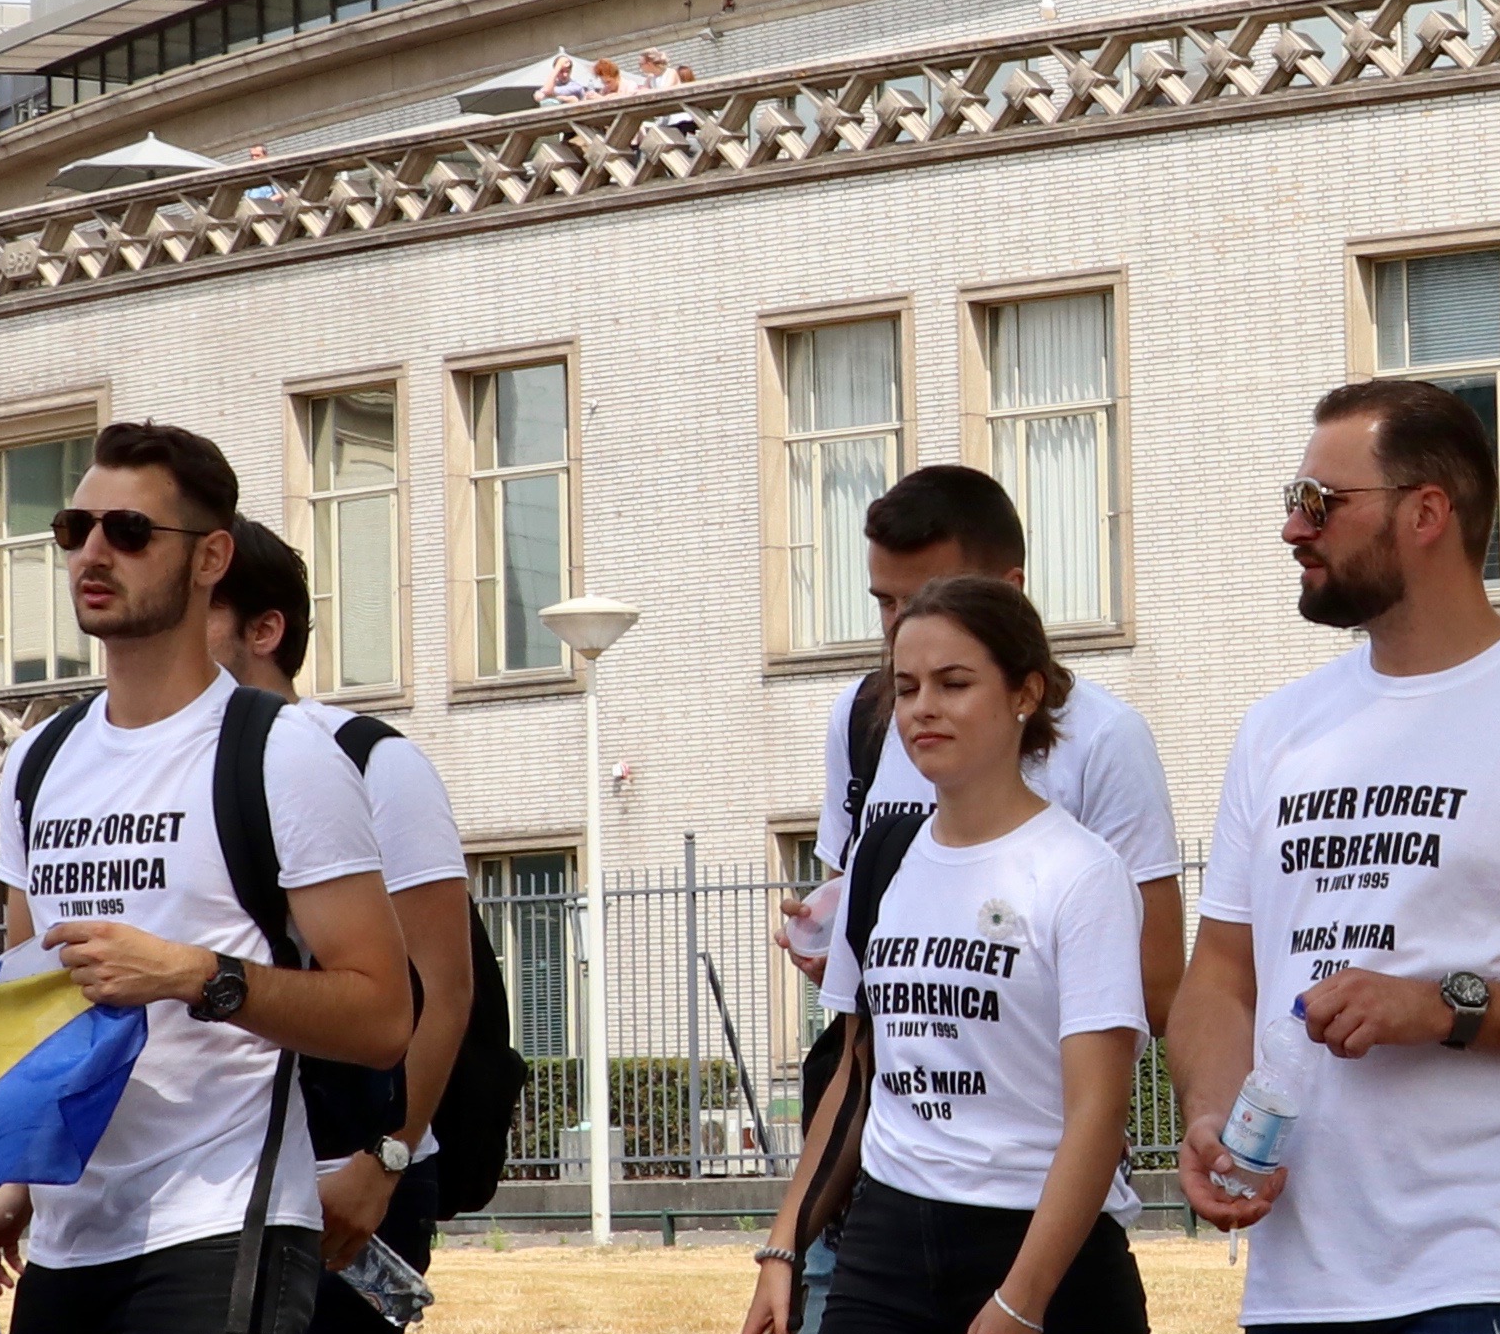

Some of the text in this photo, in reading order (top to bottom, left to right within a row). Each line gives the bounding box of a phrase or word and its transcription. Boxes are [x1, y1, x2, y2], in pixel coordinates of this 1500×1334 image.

[1276, 785, 1468, 828] NEVER FORGET
[32, 811, 186, 851] NEVER FORGET
[1280, 832, 1441, 874] SREBRENICA
[29, 857, 167, 896] SREBRENICA
[1315, 872, 1390, 893] 11 JULY 1995
[59, 898, 125, 917] 11 JULY 1995
[1290, 920, 1395, 955] MARŠ MIRA
[922, 937, 1021, 979] FORGET
[867, 982, 1000, 1022] SREBRENICA
[886, 1021, 959, 1039] 11 JULY 1995
[881, 1065, 987, 1096] MARŠ MIRA
[911, 1101, 953, 1121] 2018
